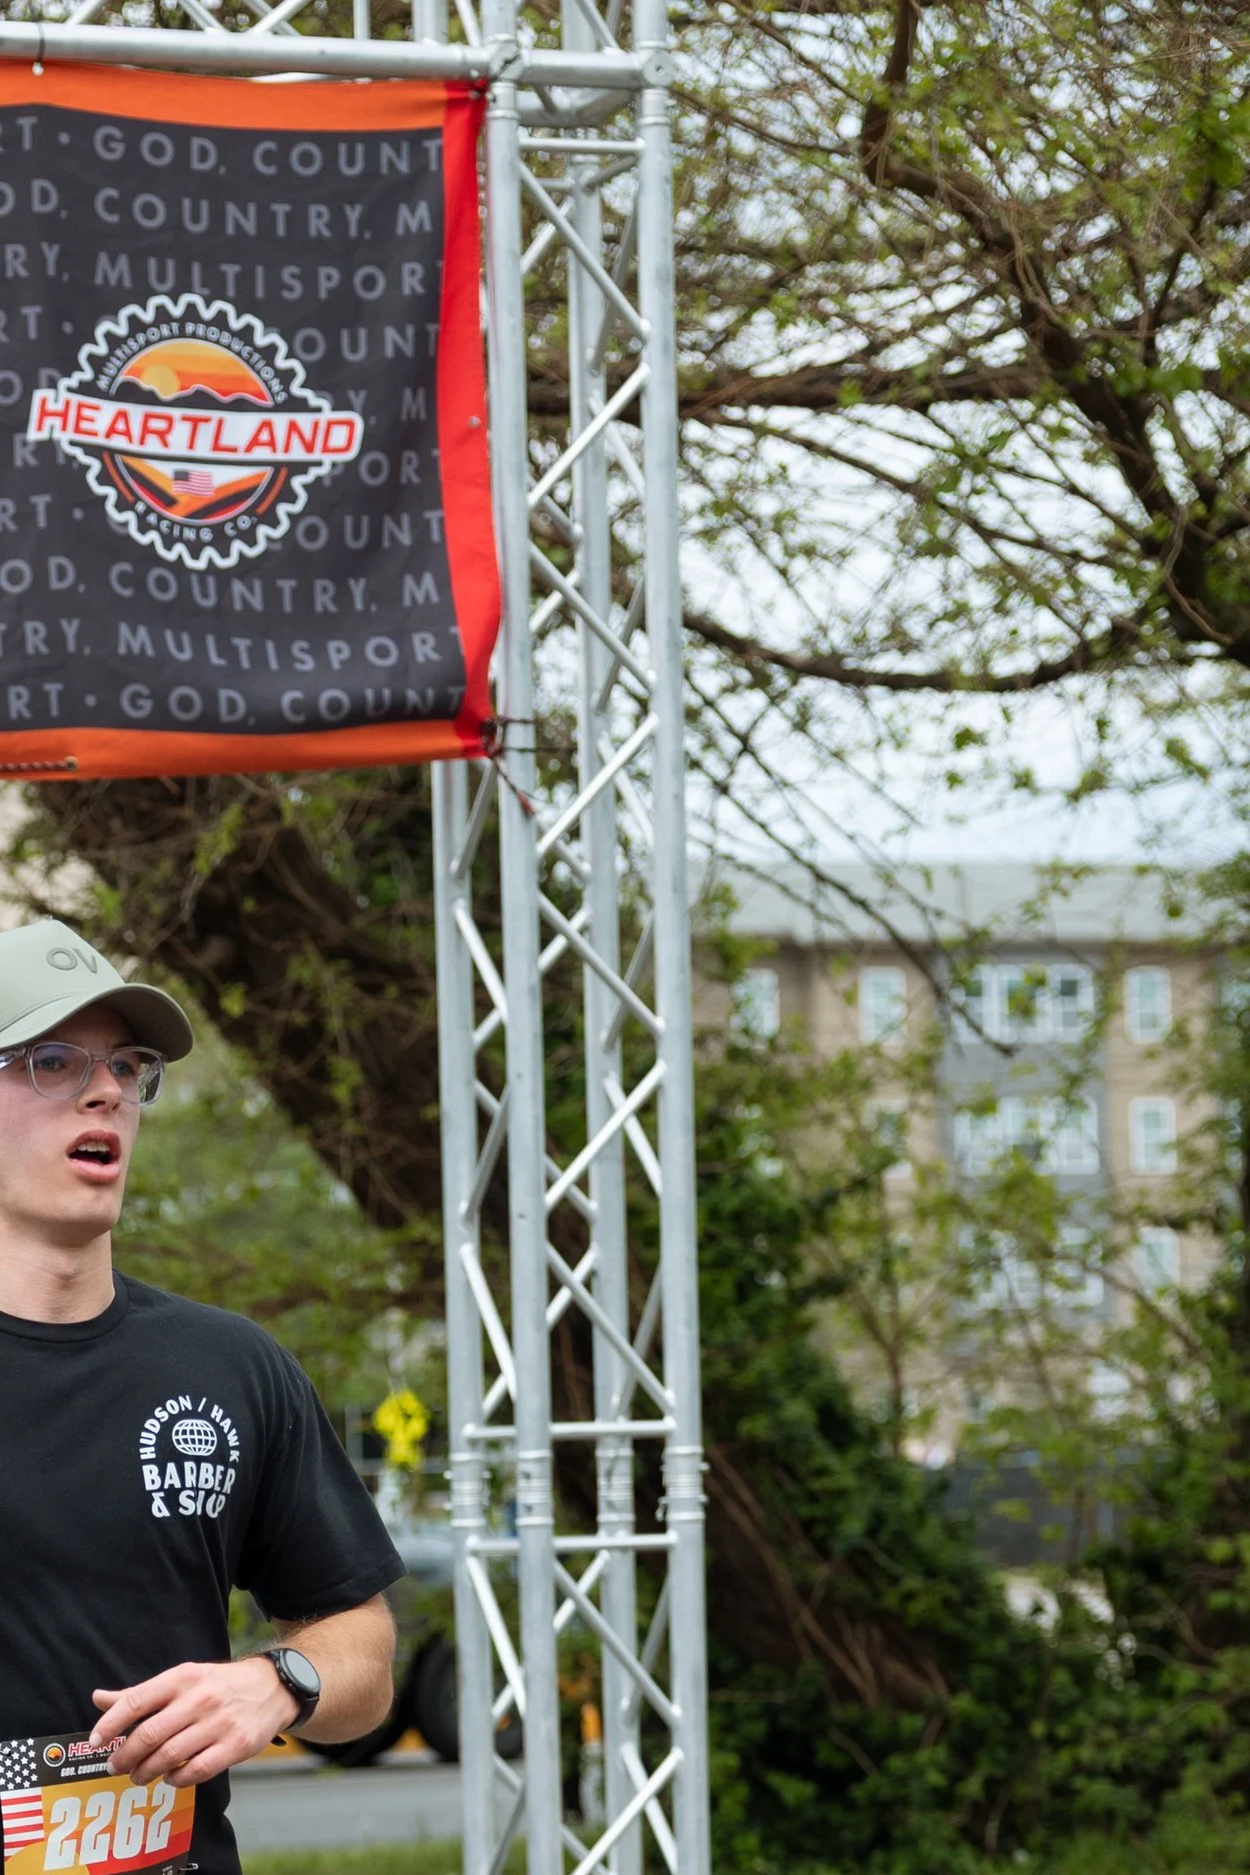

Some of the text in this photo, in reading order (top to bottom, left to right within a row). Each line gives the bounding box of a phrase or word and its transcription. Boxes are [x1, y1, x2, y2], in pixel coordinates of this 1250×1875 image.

[396, 200, 431, 235] M
[96, 322, 179, 393] MULTISPORT
[185, 322, 289, 405] PRODUCTIONS
[34, 394, 357, 456] HEARTLAND
[134, 502, 214, 542] RACING
[265, 509, 444, 550] OUNT
[403, 571, 441, 607] M
[139, 1395, 193, 1460] HUDSON
[210, 1404, 240, 1463] HAWK
[142, 1460, 236, 1495] BARBER
[151, 1491, 171, 1518] &
[43, 1781, 177, 1872] 2262
